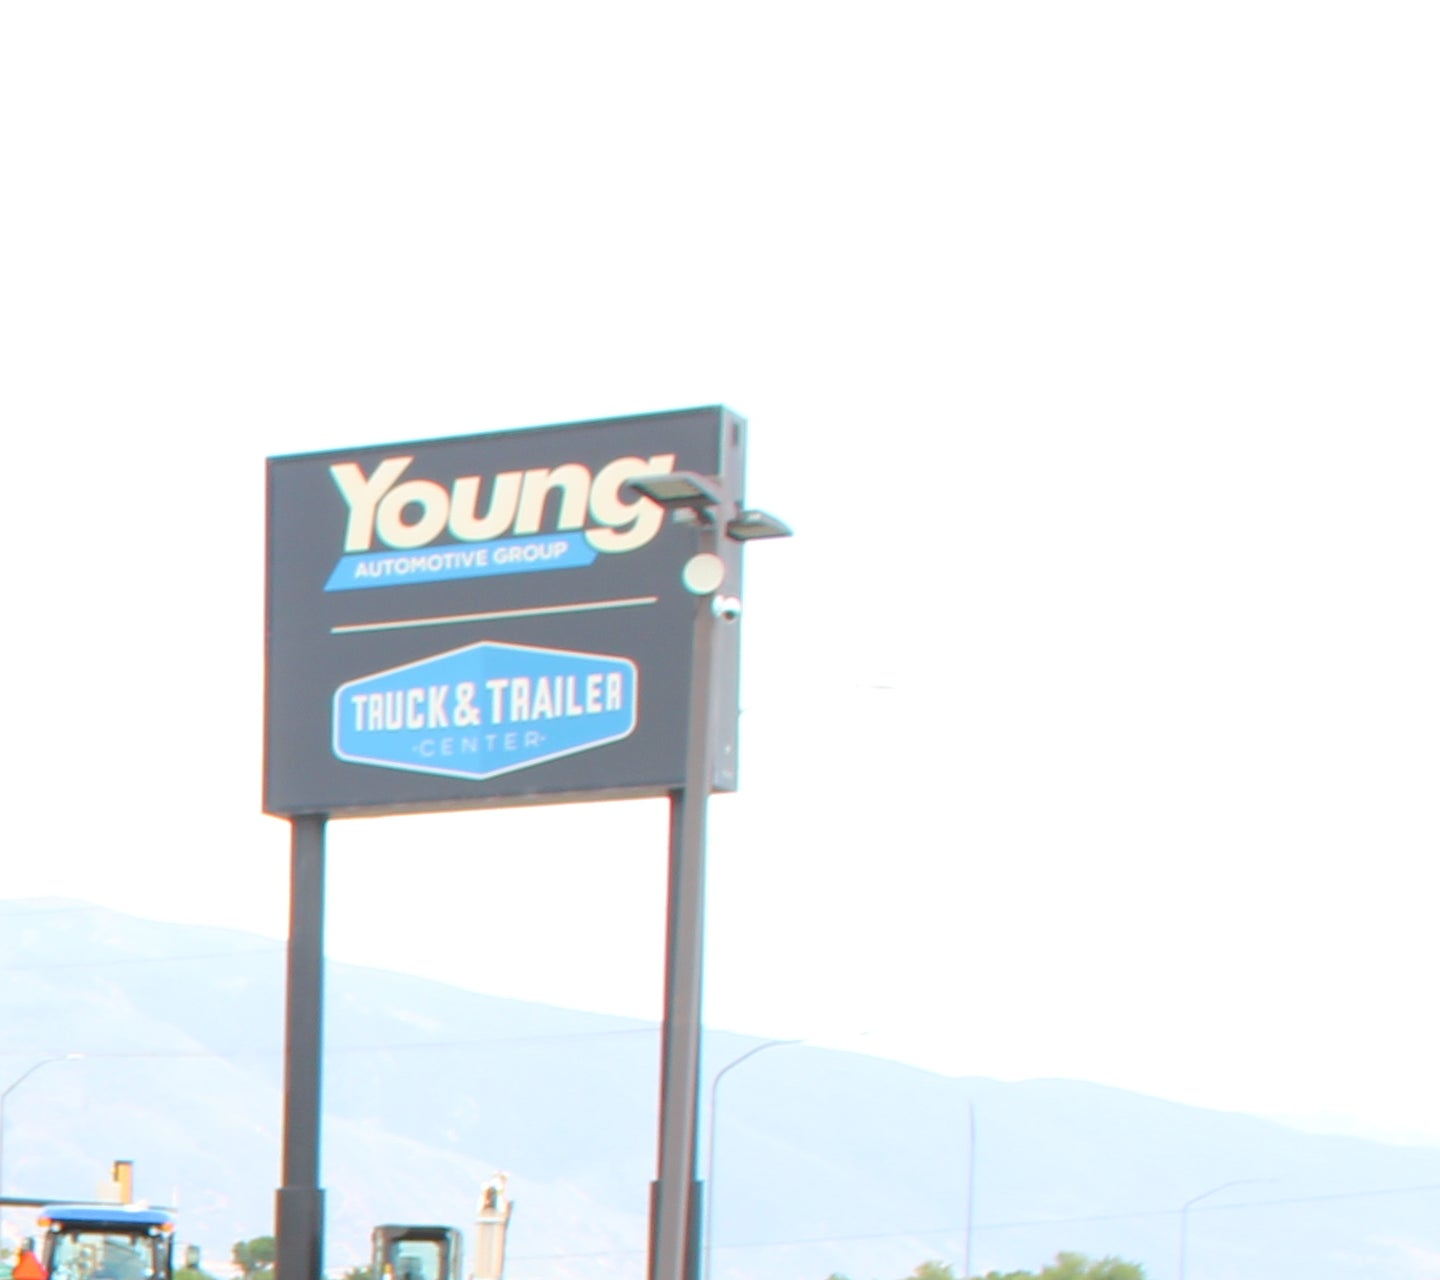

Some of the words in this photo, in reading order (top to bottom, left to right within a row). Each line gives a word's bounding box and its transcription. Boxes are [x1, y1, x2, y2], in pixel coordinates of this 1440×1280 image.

[330, 454, 675, 554] Young
[354, 548, 488, 579] AUTOMOTIVE
[494, 540, 569, 566] GROUP
[351, 685, 449, 731] TRUCK
[453, 682, 481, 727] &
[485, 671, 623, 724] TRAILER
[418, 730, 540, 758] CENTER
